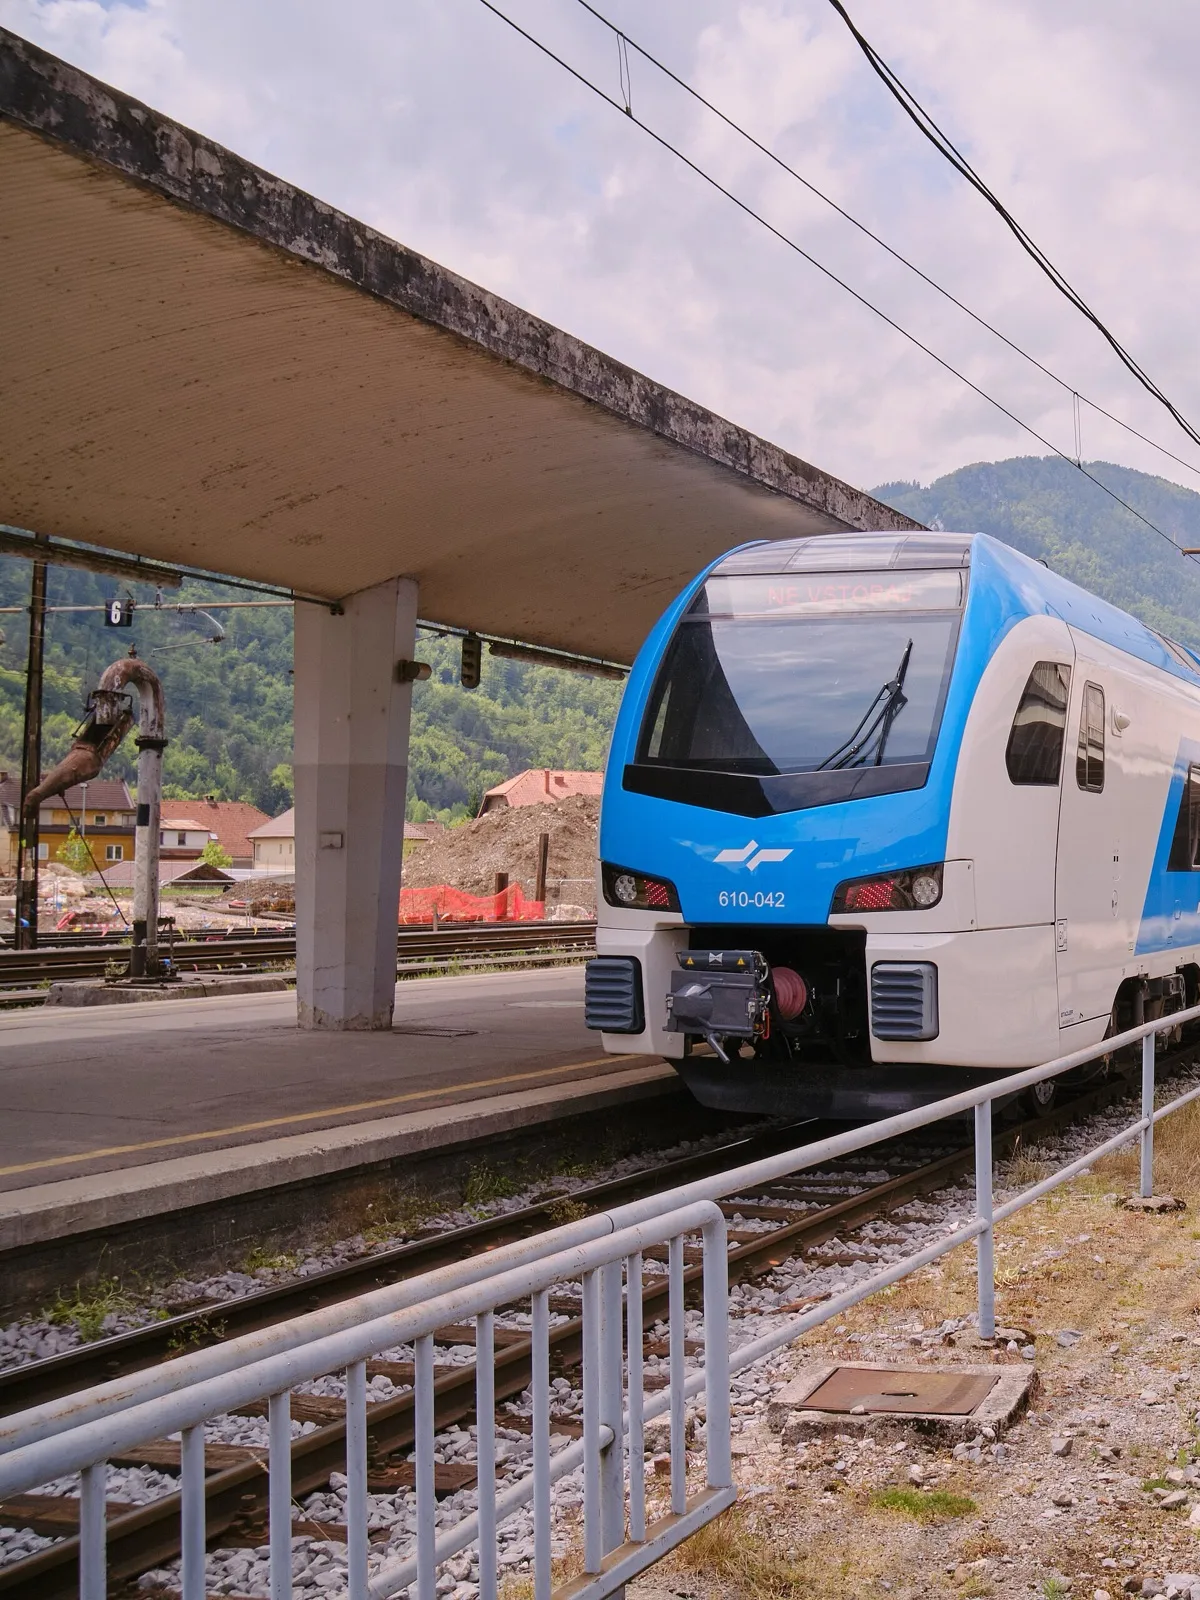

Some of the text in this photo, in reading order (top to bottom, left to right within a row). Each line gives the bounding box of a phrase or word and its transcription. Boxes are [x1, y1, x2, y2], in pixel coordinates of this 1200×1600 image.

[767, 586, 799, 606] NE
[110, 600, 122, 624] 6
[718, 890, 786, 908] 610-042
